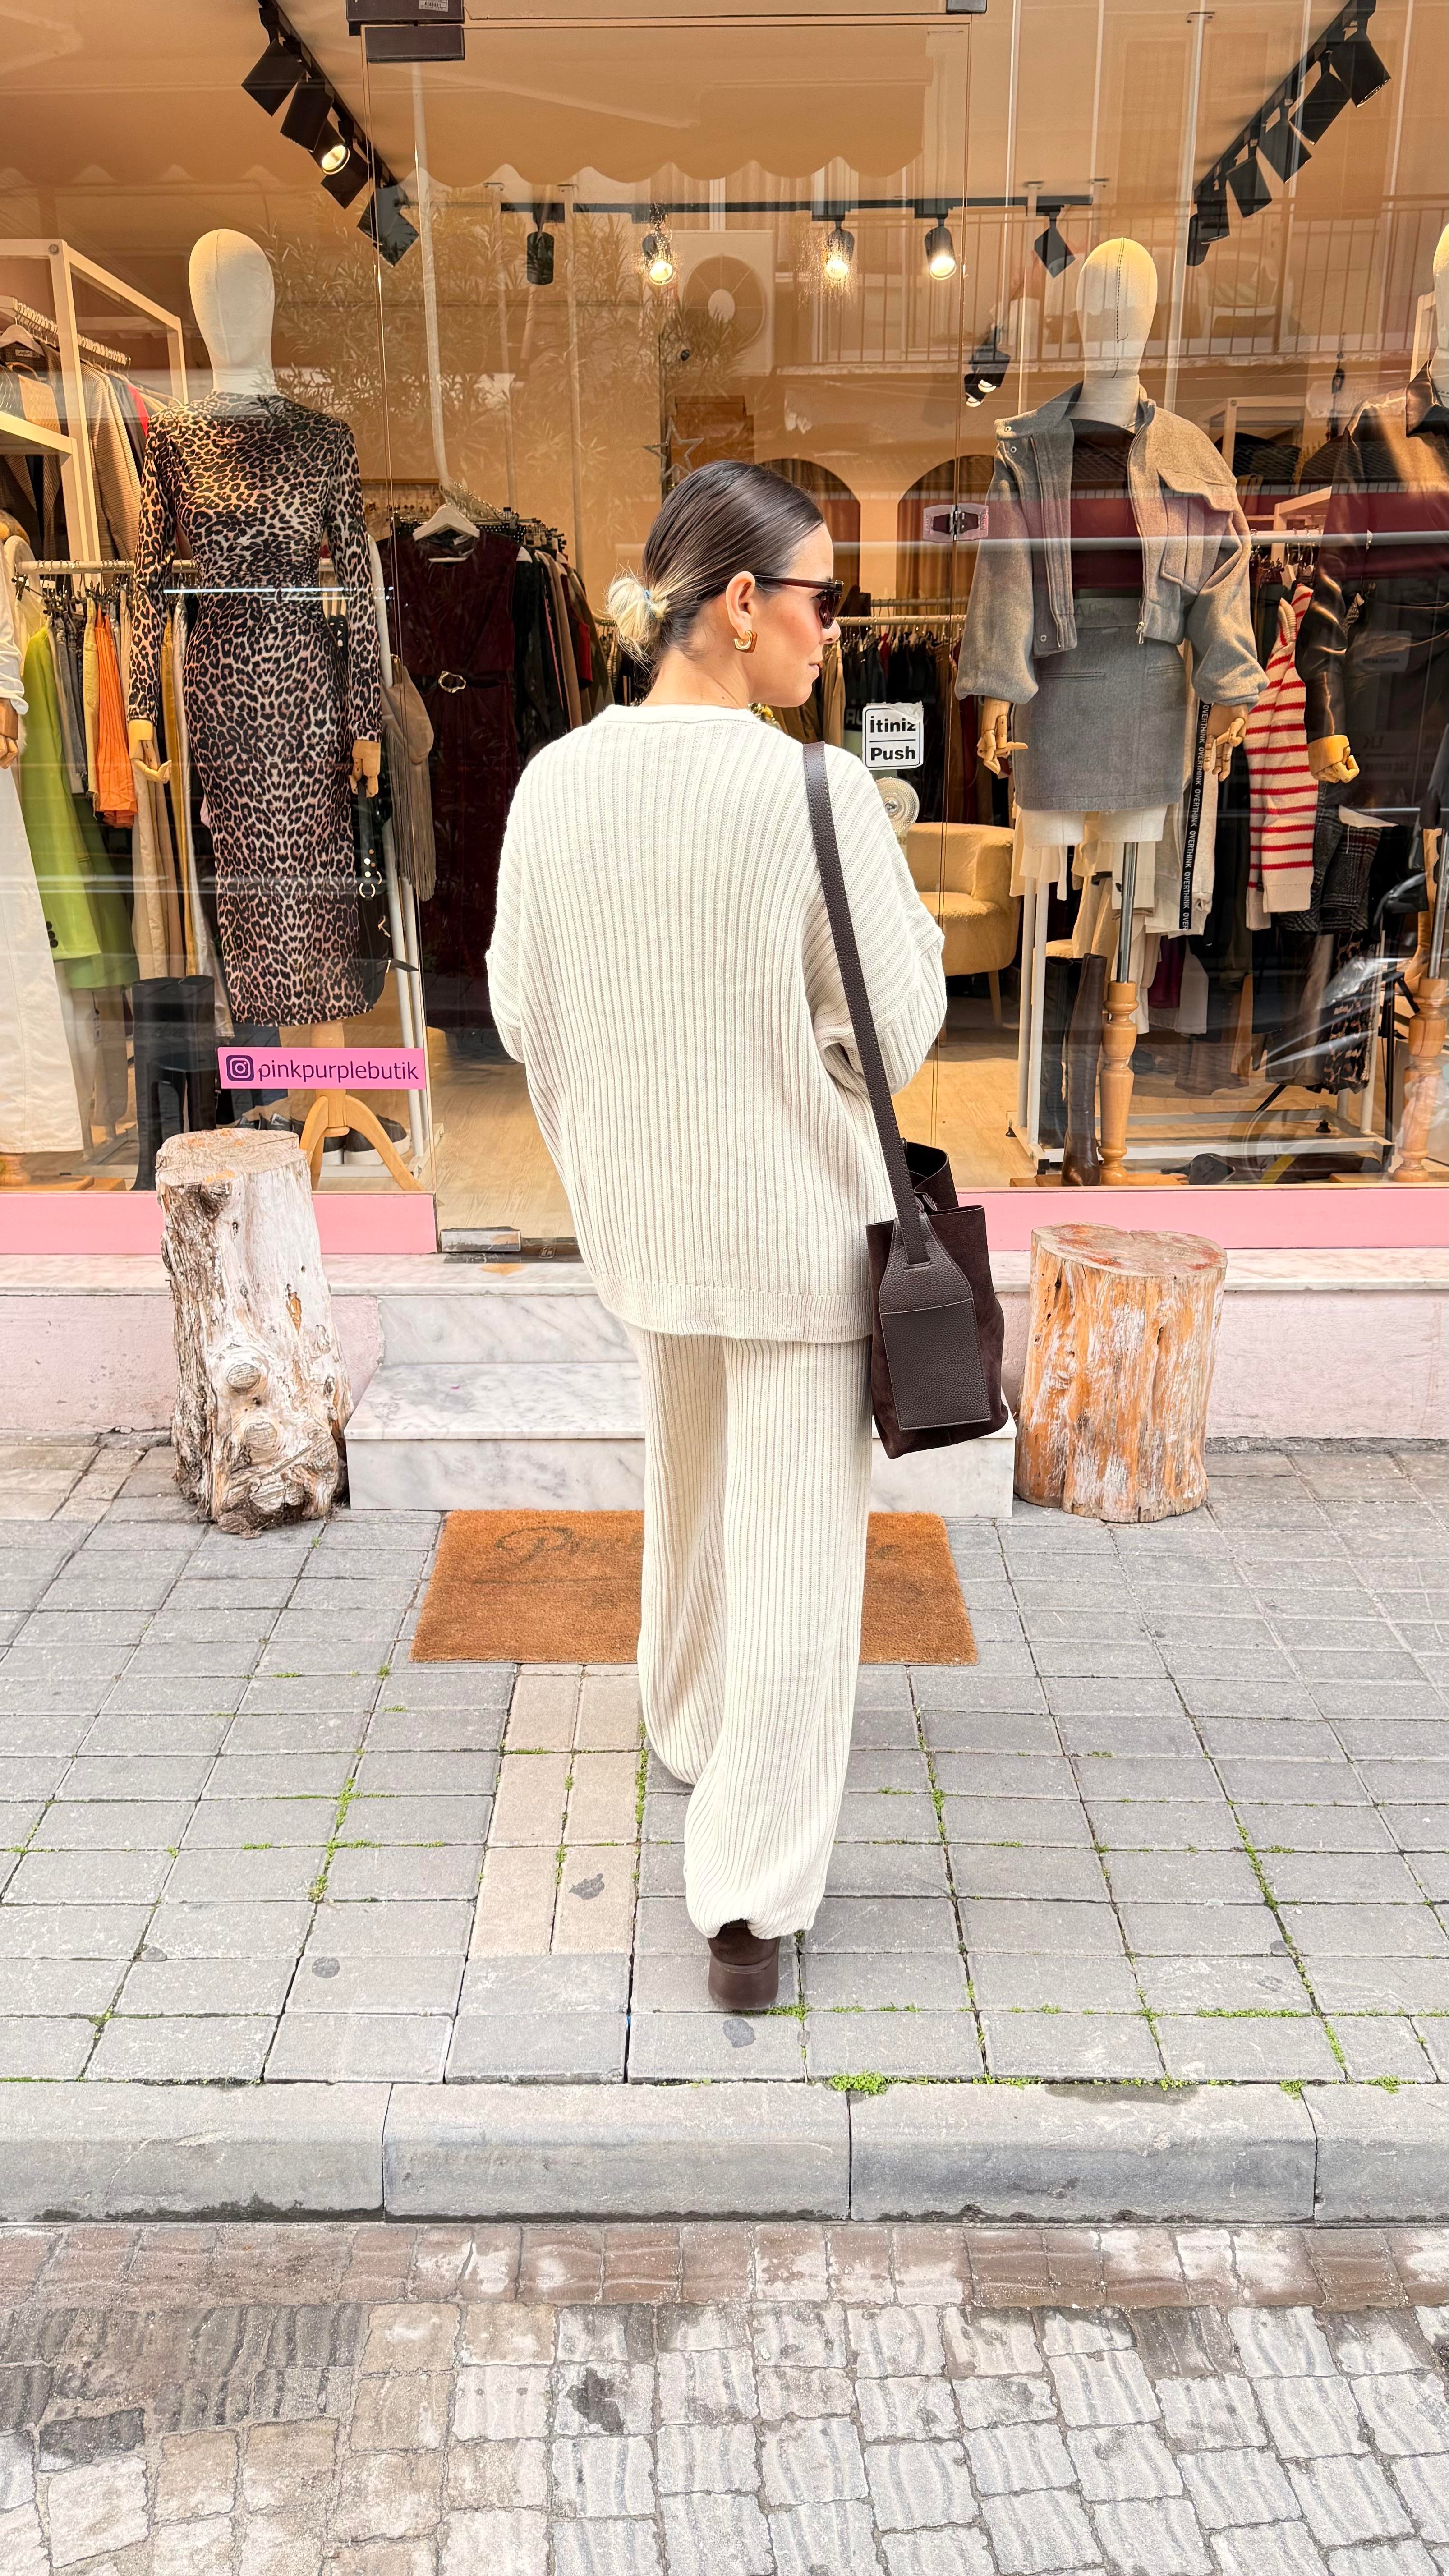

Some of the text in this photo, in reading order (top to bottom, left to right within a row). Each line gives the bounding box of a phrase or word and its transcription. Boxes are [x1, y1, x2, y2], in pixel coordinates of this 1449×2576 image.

[1199, 704, 1209, 743] OVERTHINK
[870, 746, 915, 761] Push
[1195, 746, 1205, 785] OVERTHINK
[1191, 789, 1201, 827] OVERTHINK
[1185, 830, 1196, 868] OVERTHINK
[1183, 871, 1191, 909] OVERTHINK
[258, 1059, 419, 1083] pinkpurplebutik
